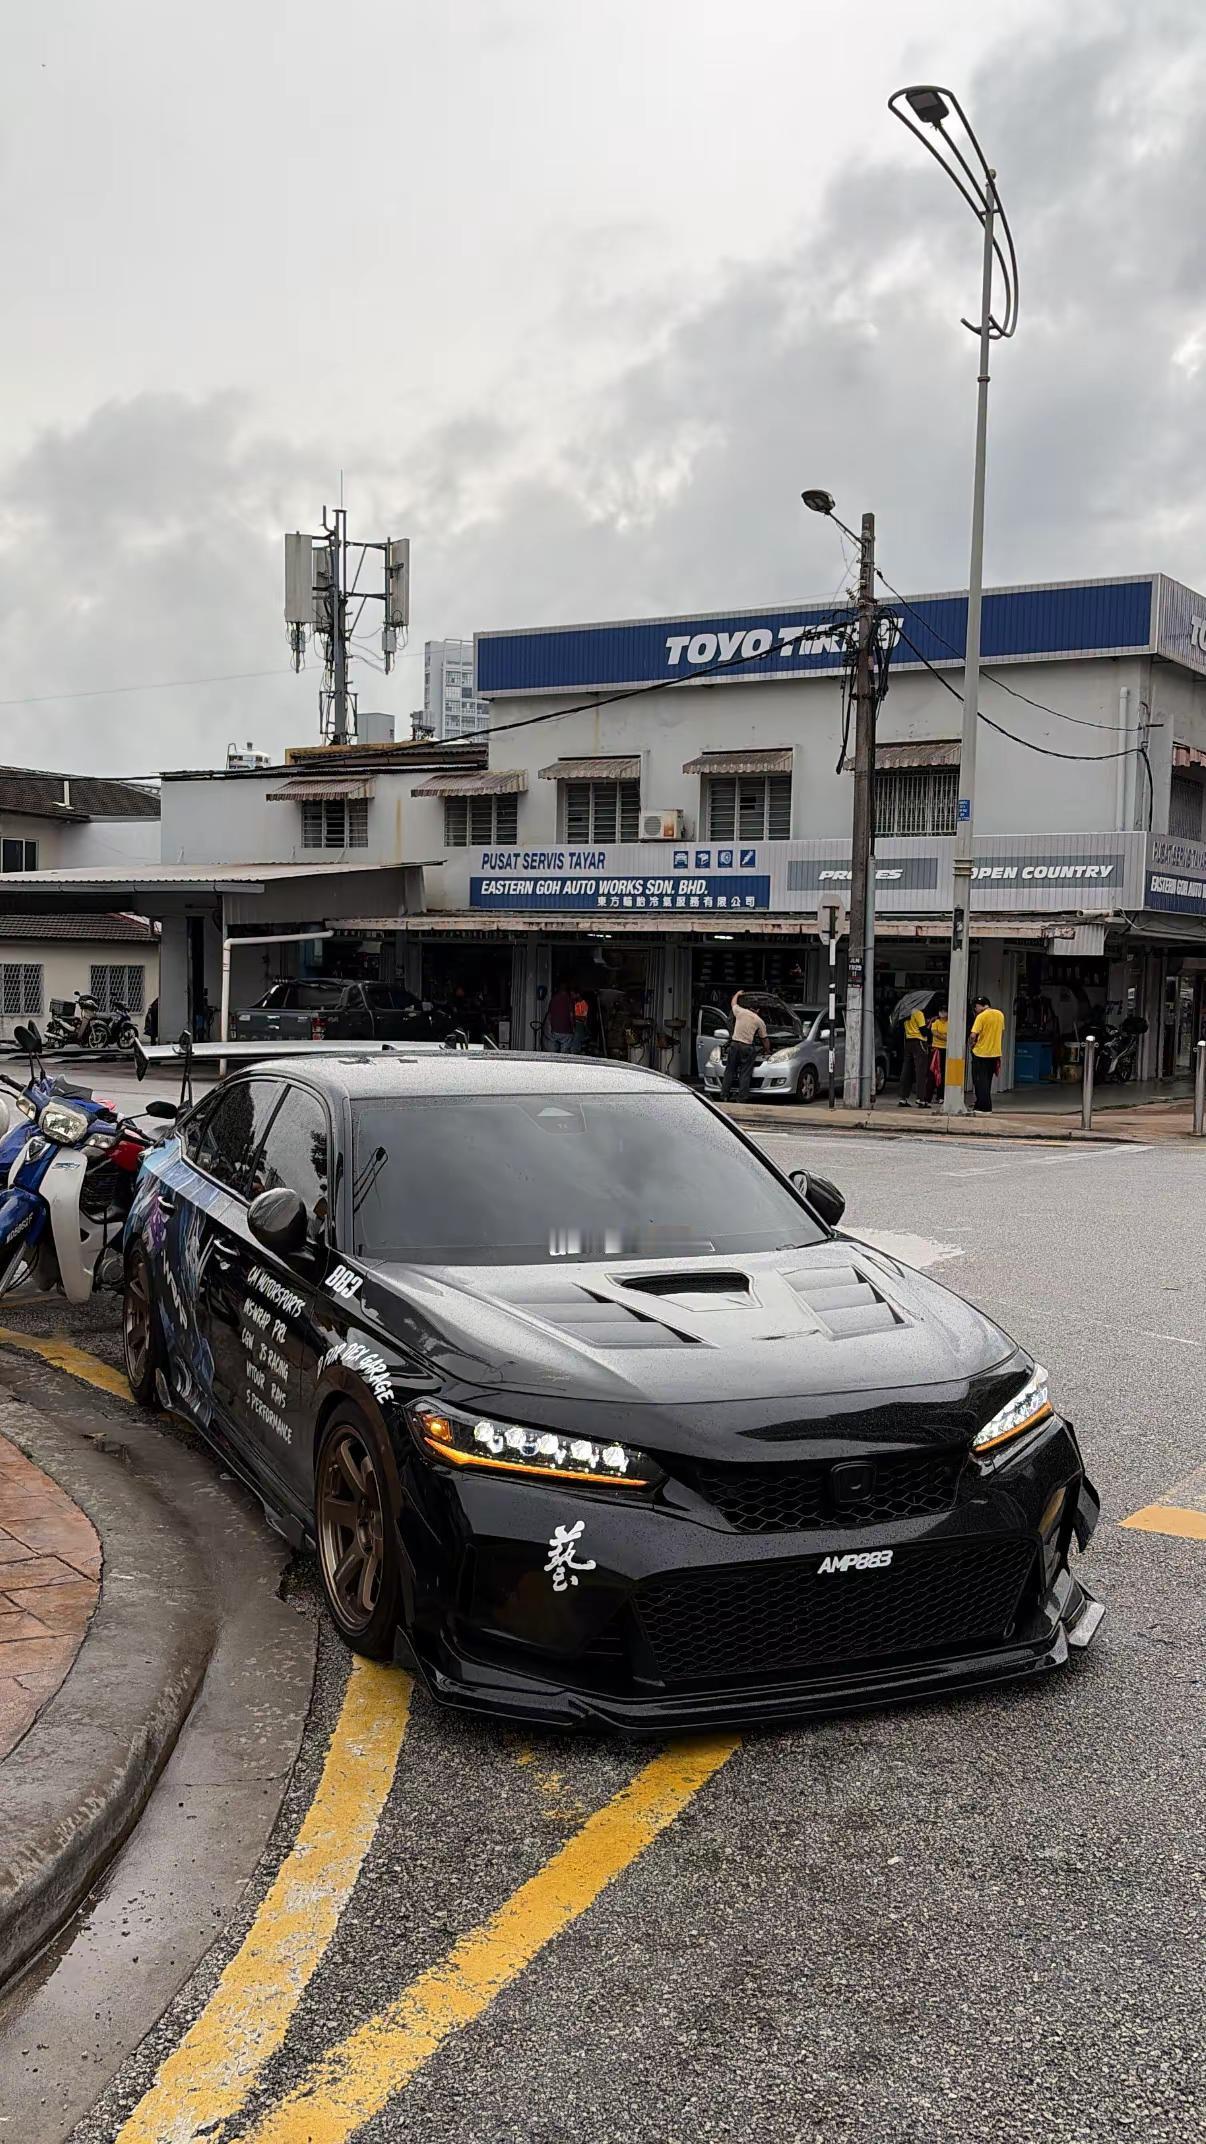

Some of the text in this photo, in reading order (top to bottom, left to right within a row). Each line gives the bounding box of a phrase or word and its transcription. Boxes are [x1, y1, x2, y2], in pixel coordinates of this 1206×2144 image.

[665, 628, 773, 665] TOYO
[481, 851, 606, 870] PUSAT SERVIS TAYAR
[1021, 865, 1114, 879] COUNTRY
[481, 879, 708, 895] EASTERN GOH AUTO WORKS SDN. BHD.
[818, 869, 903, 880] PRES
[324, 1264, 364, 1299] 883
[255, 1272, 306, 1318] MOTORSPORTS
[359, 1353, 395, 1405] GARAGE
[817, 1550, 893, 1575] AMP883
